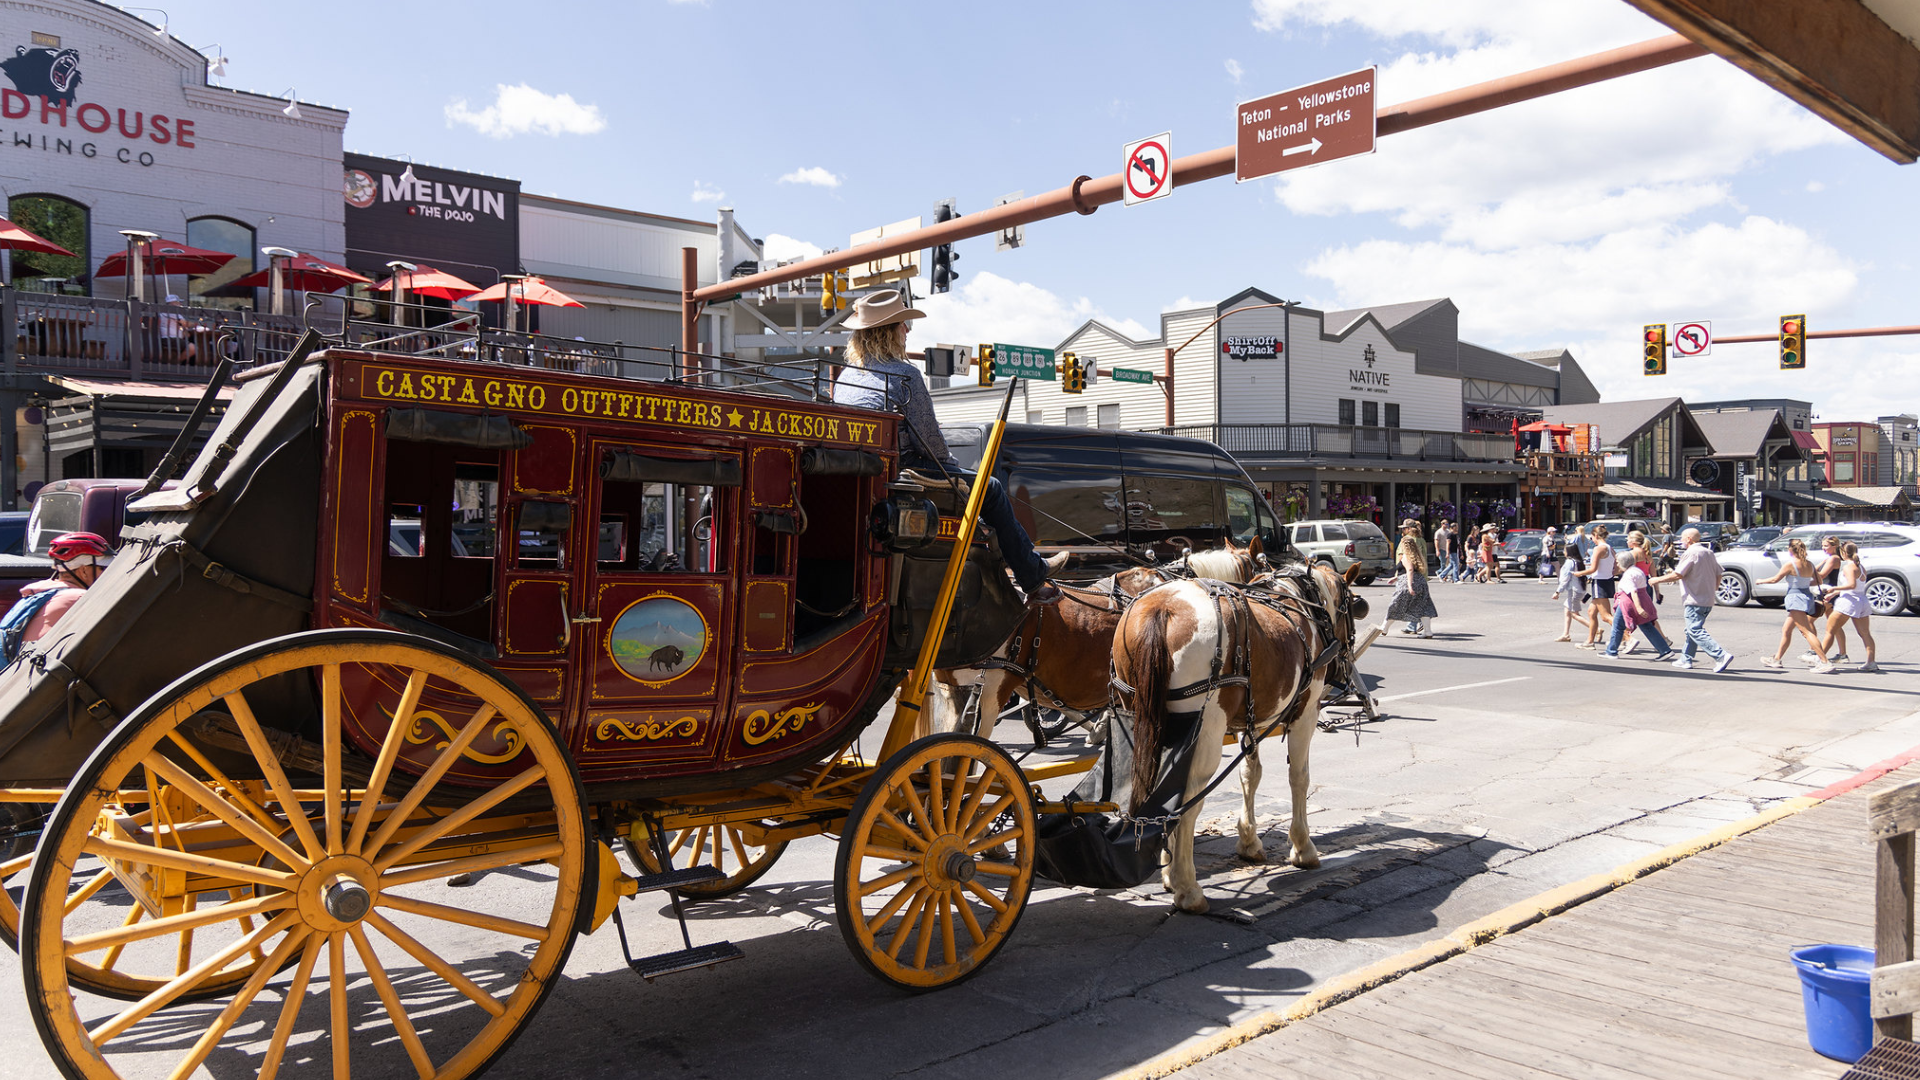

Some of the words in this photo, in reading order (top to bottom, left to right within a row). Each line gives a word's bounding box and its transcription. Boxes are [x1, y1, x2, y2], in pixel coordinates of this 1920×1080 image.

[1241, 108, 1271, 126] Teton
[1298, 81, 1371, 111] Yellowstone
[2, 88, 195, 149] DHOUSE
[1257, 117, 1308, 143] National
[1315, 109, 1351, 128] Parks
[0, 128, 97, 158] WING
[117, 147, 154, 167] CO
[382, 173, 505, 221] MELVIN
[417, 204, 442, 218] THE
[445, 210, 474, 223] DOJO
[1227, 336, 1276, 346] ShirtOff
[999, 353, 1006, 362] 26
[1012, 354, 1019, 363] 89
[1229, 345, 1275, 357] MyBack
[1021, 369, 1041, 377] JUNCTION
[1115, 370, 1140, 381] BROADWAY
[1141, 373, 1151, 381] AVE
[1349, 369, 1390, 386] NATIVE
[376, 370, 546, 410] CASTAGNO
[561, 388, 722, 427] OUTFITTERS
[749, 409, 840, 440] JACKSON
[846, 421, 877, 443] WY
[1737, 461, 1745, 484] RIVER
